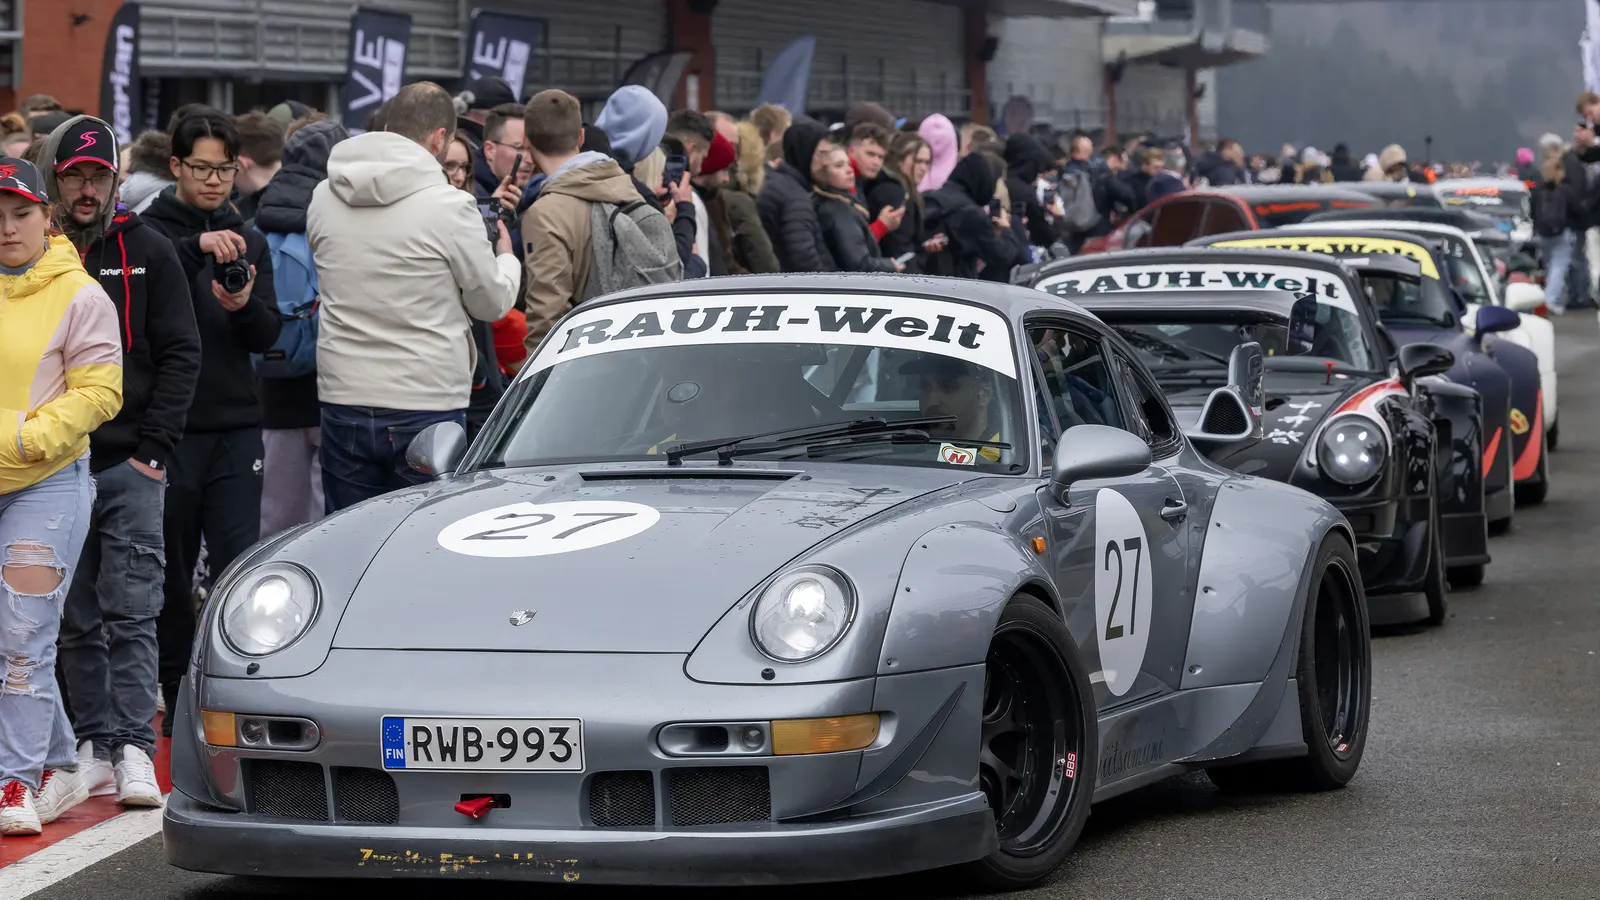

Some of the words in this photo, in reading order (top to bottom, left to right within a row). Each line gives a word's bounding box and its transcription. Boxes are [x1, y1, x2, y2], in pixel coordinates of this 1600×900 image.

[556, 305, 986, 354] RAUH-Welt
[462, 512, 638, 541] 27
[1104, 536, 1142, 641] 27
[385, 748, 405, 760] FIN
[411, 725, 573, 763] RWB-993
[1065, 752, 1076, 778] BBS
